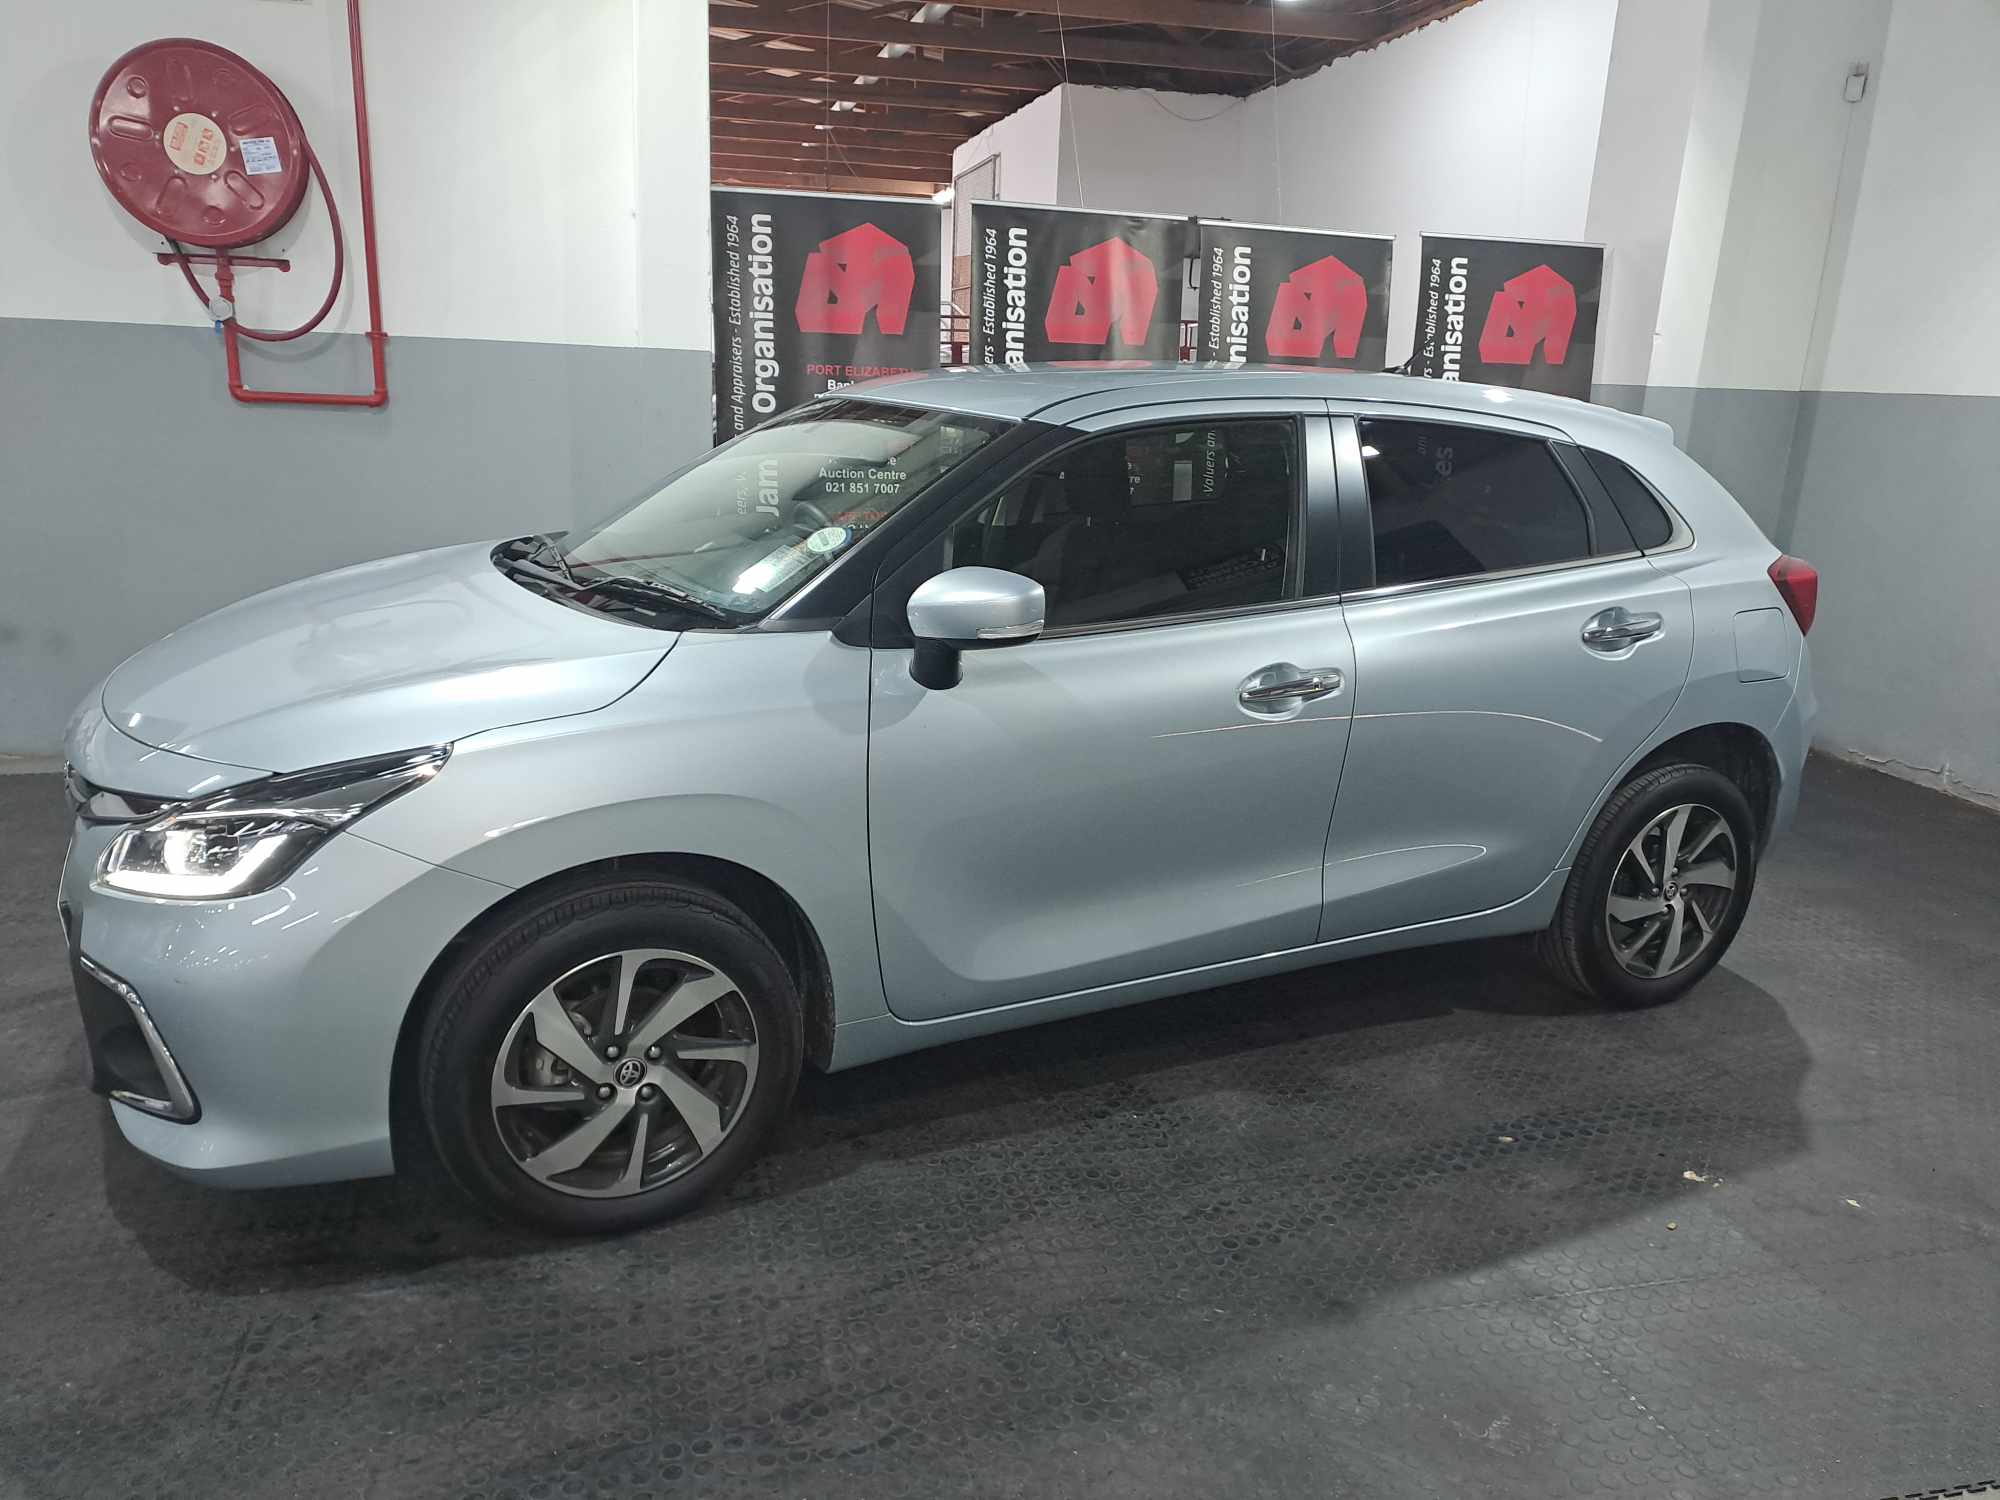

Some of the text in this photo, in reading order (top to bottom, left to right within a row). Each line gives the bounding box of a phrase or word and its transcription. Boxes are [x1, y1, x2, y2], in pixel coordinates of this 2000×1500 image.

[727, 215, 739, 246] 1964
[985, 228, 998, 259] 1964
[1212, 247, 1225, 277] 1964
[1429, 258, 1442, 287] 1964
[727, 249, 741, 325] Established
[982, 261, 996, 335] Established
[748, 213, 780, 413] Organisation
[1208, 279, 1222, 349] Established
[729, 335, 744, 404] Appraisers
[807, 363, 841, 375] PORT
[730, 405, 744, 431] and
[818, 467, 907, 480] Auction Centre
[1203, 430, 1216, 494] Valuers an
[756, 459, 779, 517] Jam
[825, 482, 900, 494] 021 851 7007
